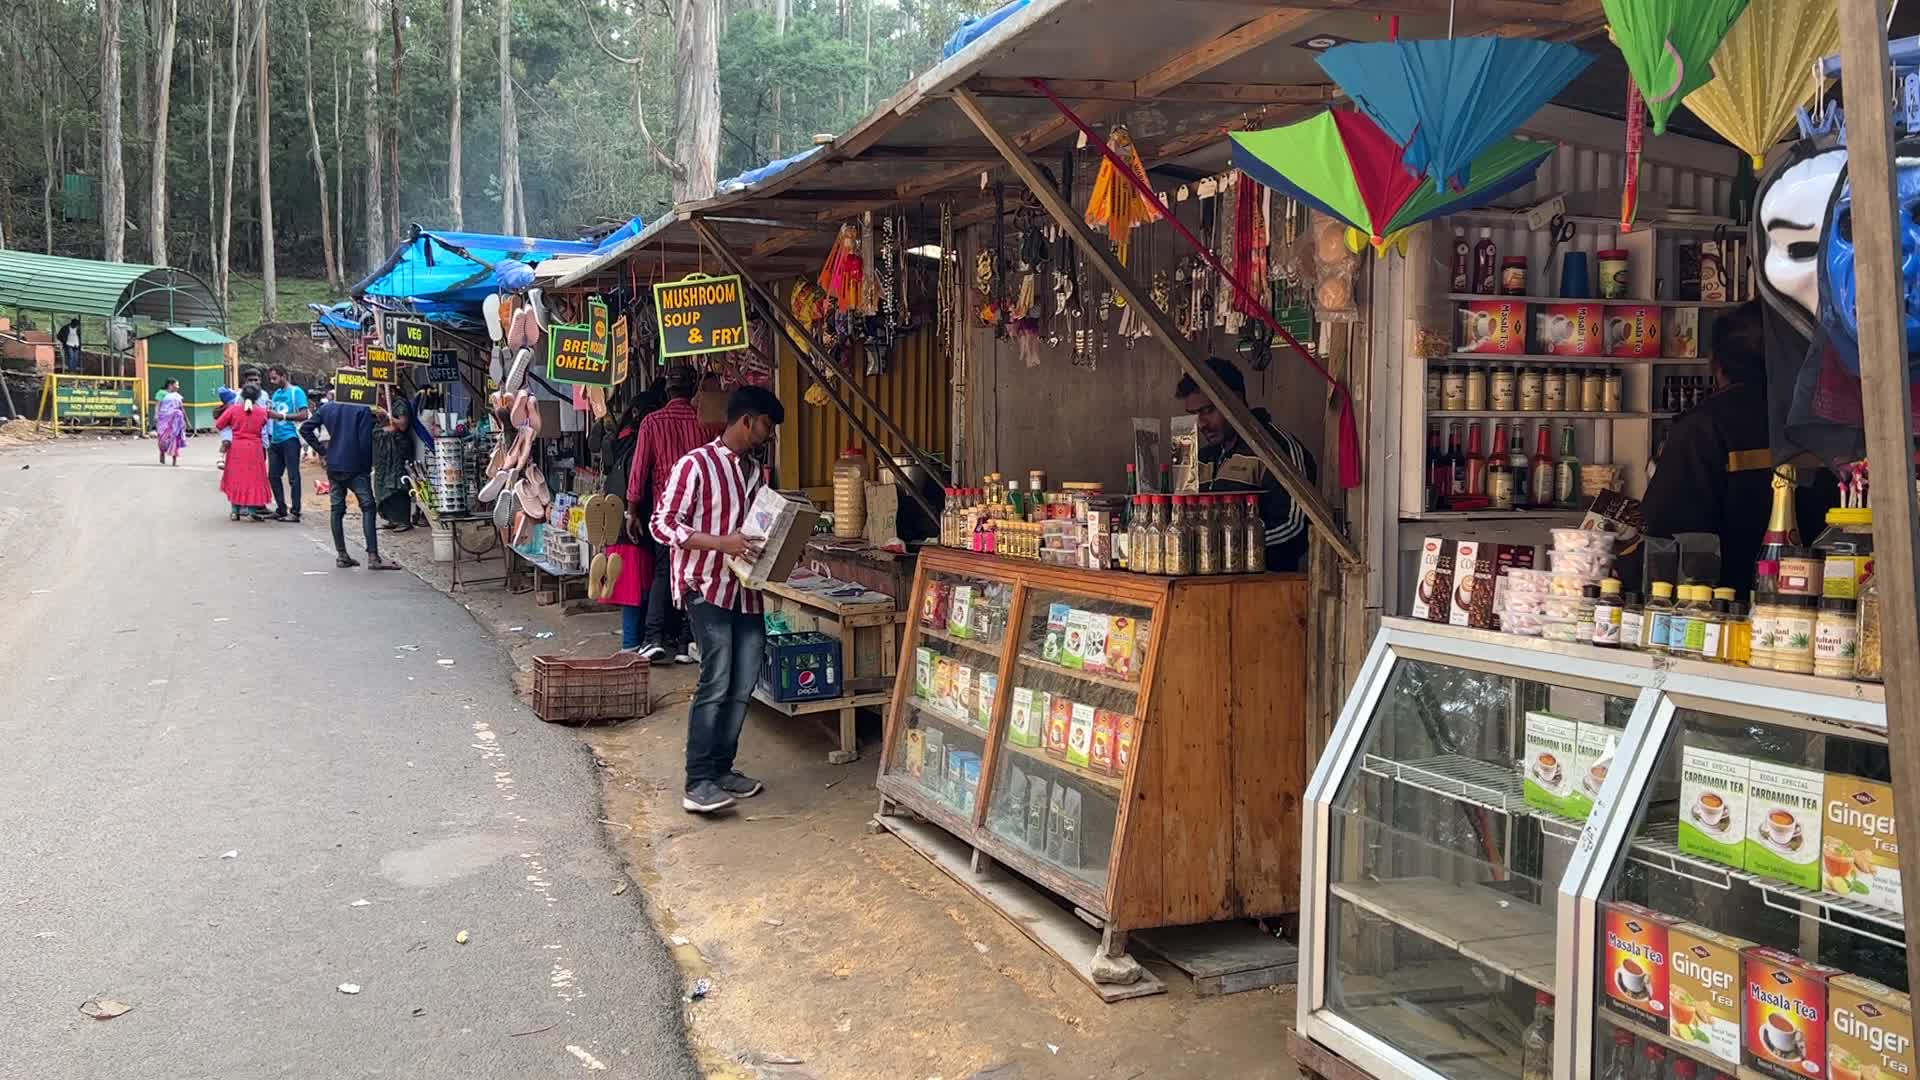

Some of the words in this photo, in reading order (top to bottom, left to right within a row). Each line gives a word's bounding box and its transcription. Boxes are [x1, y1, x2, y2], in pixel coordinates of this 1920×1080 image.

[662, 283, 735, 309] MUSHROOM
[664, 311, 700, 328] SOUP
[407, 327, 422, 341] VEG
[688, 328, 704, 344] &
[712, 327, 742, 346] FRY
[368, 350, 394, 362] TOMATO
[397, 344, 429, 359] NOODLES
[432, 353, 449, 365] TEA
[351, 389, 364, 400] FRY
[797, 687, 819, 696] pepsi
[1684, 770, 1728, 790] CARDAMOM
[1729, 781, 1744, 794] TEA
[1750, 786, 1799, 808] CARDAMOM
[1802, 798, 1817, 811] TEA
[1872, 837, 1899, 854] Tea
[1608, 931, 1641, 957] Masala
[1643, 945, 1664, 966] Tea
[1672, 952, 1734, 989] Ginger
[1710, 990, 1733, 1008] Tea
[1750, 982, 1792, 1011] Masala
[1793, 1000, 1818, 1021] Tea
[1833, 1008, 1910, 1054] Ginger
[1881, 1053, 1909, 1075] Tea
